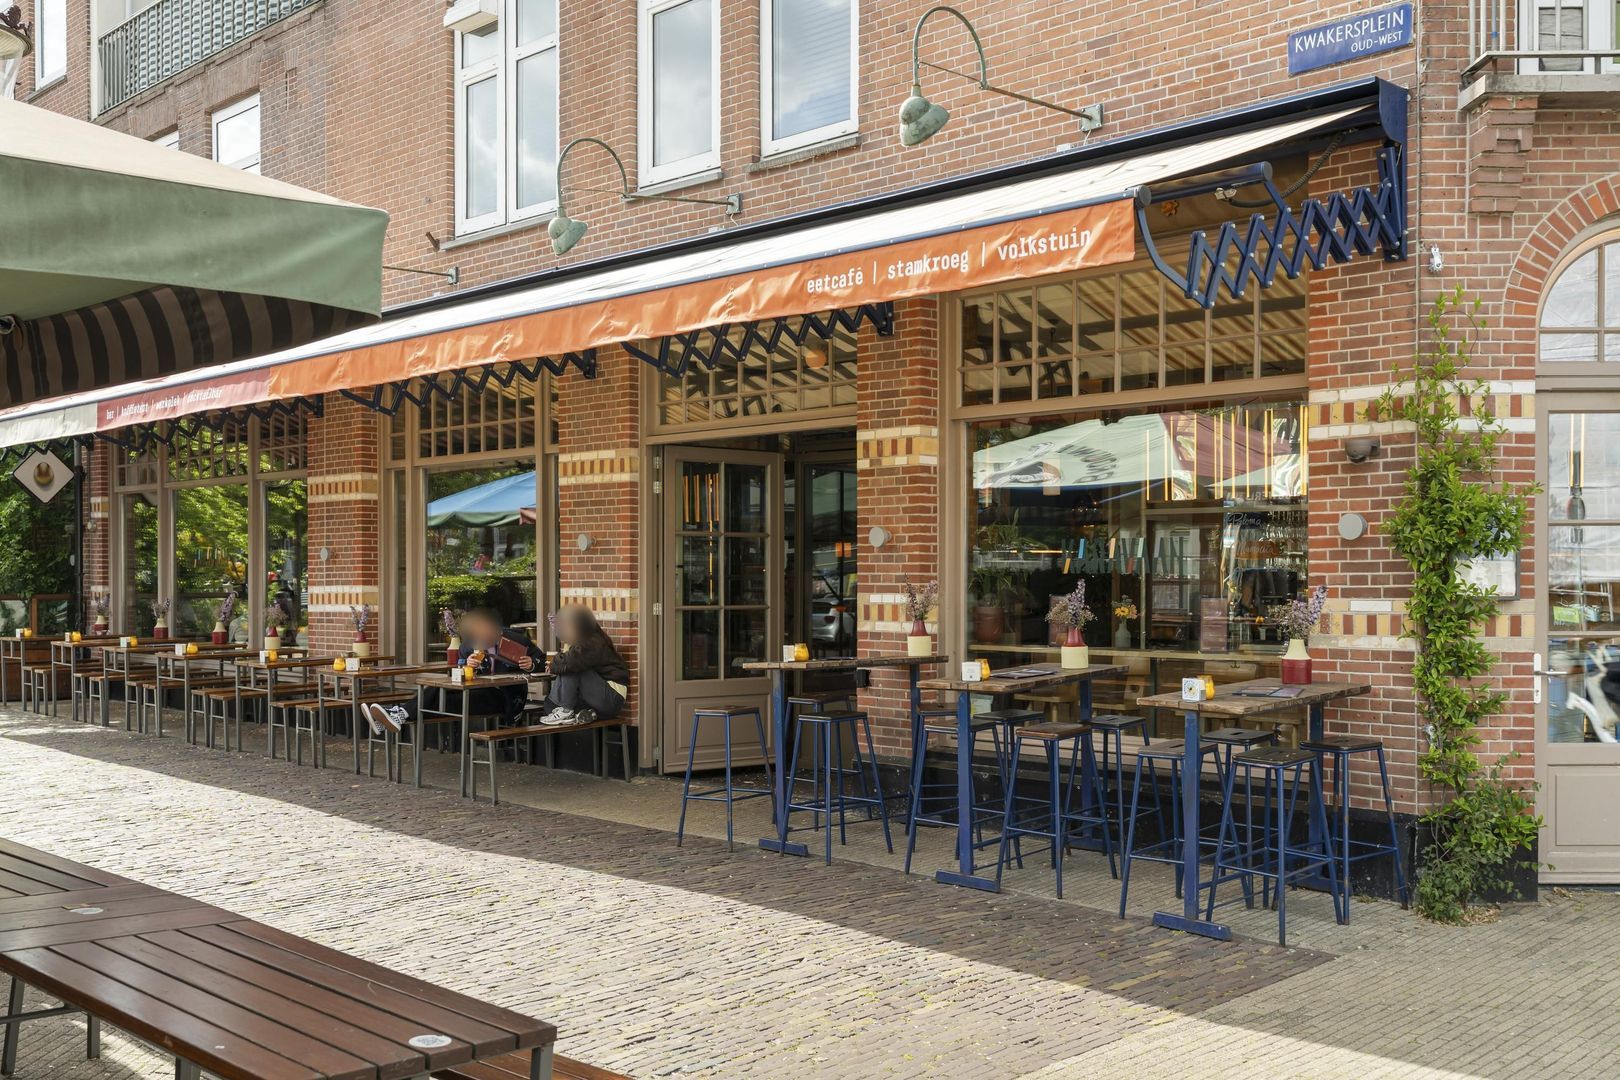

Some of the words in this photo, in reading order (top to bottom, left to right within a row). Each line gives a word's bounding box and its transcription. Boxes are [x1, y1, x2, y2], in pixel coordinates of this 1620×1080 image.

[1295, 9, 1404, 53] KWAKERSPLEIN
[1350, 30, 1403, 53] OUD-WEST
[807, 267, 864, 293] eetcafé
[887, 250, 969, 280] stamkroeg
[998, 226, 1092, 261] volkstuin
